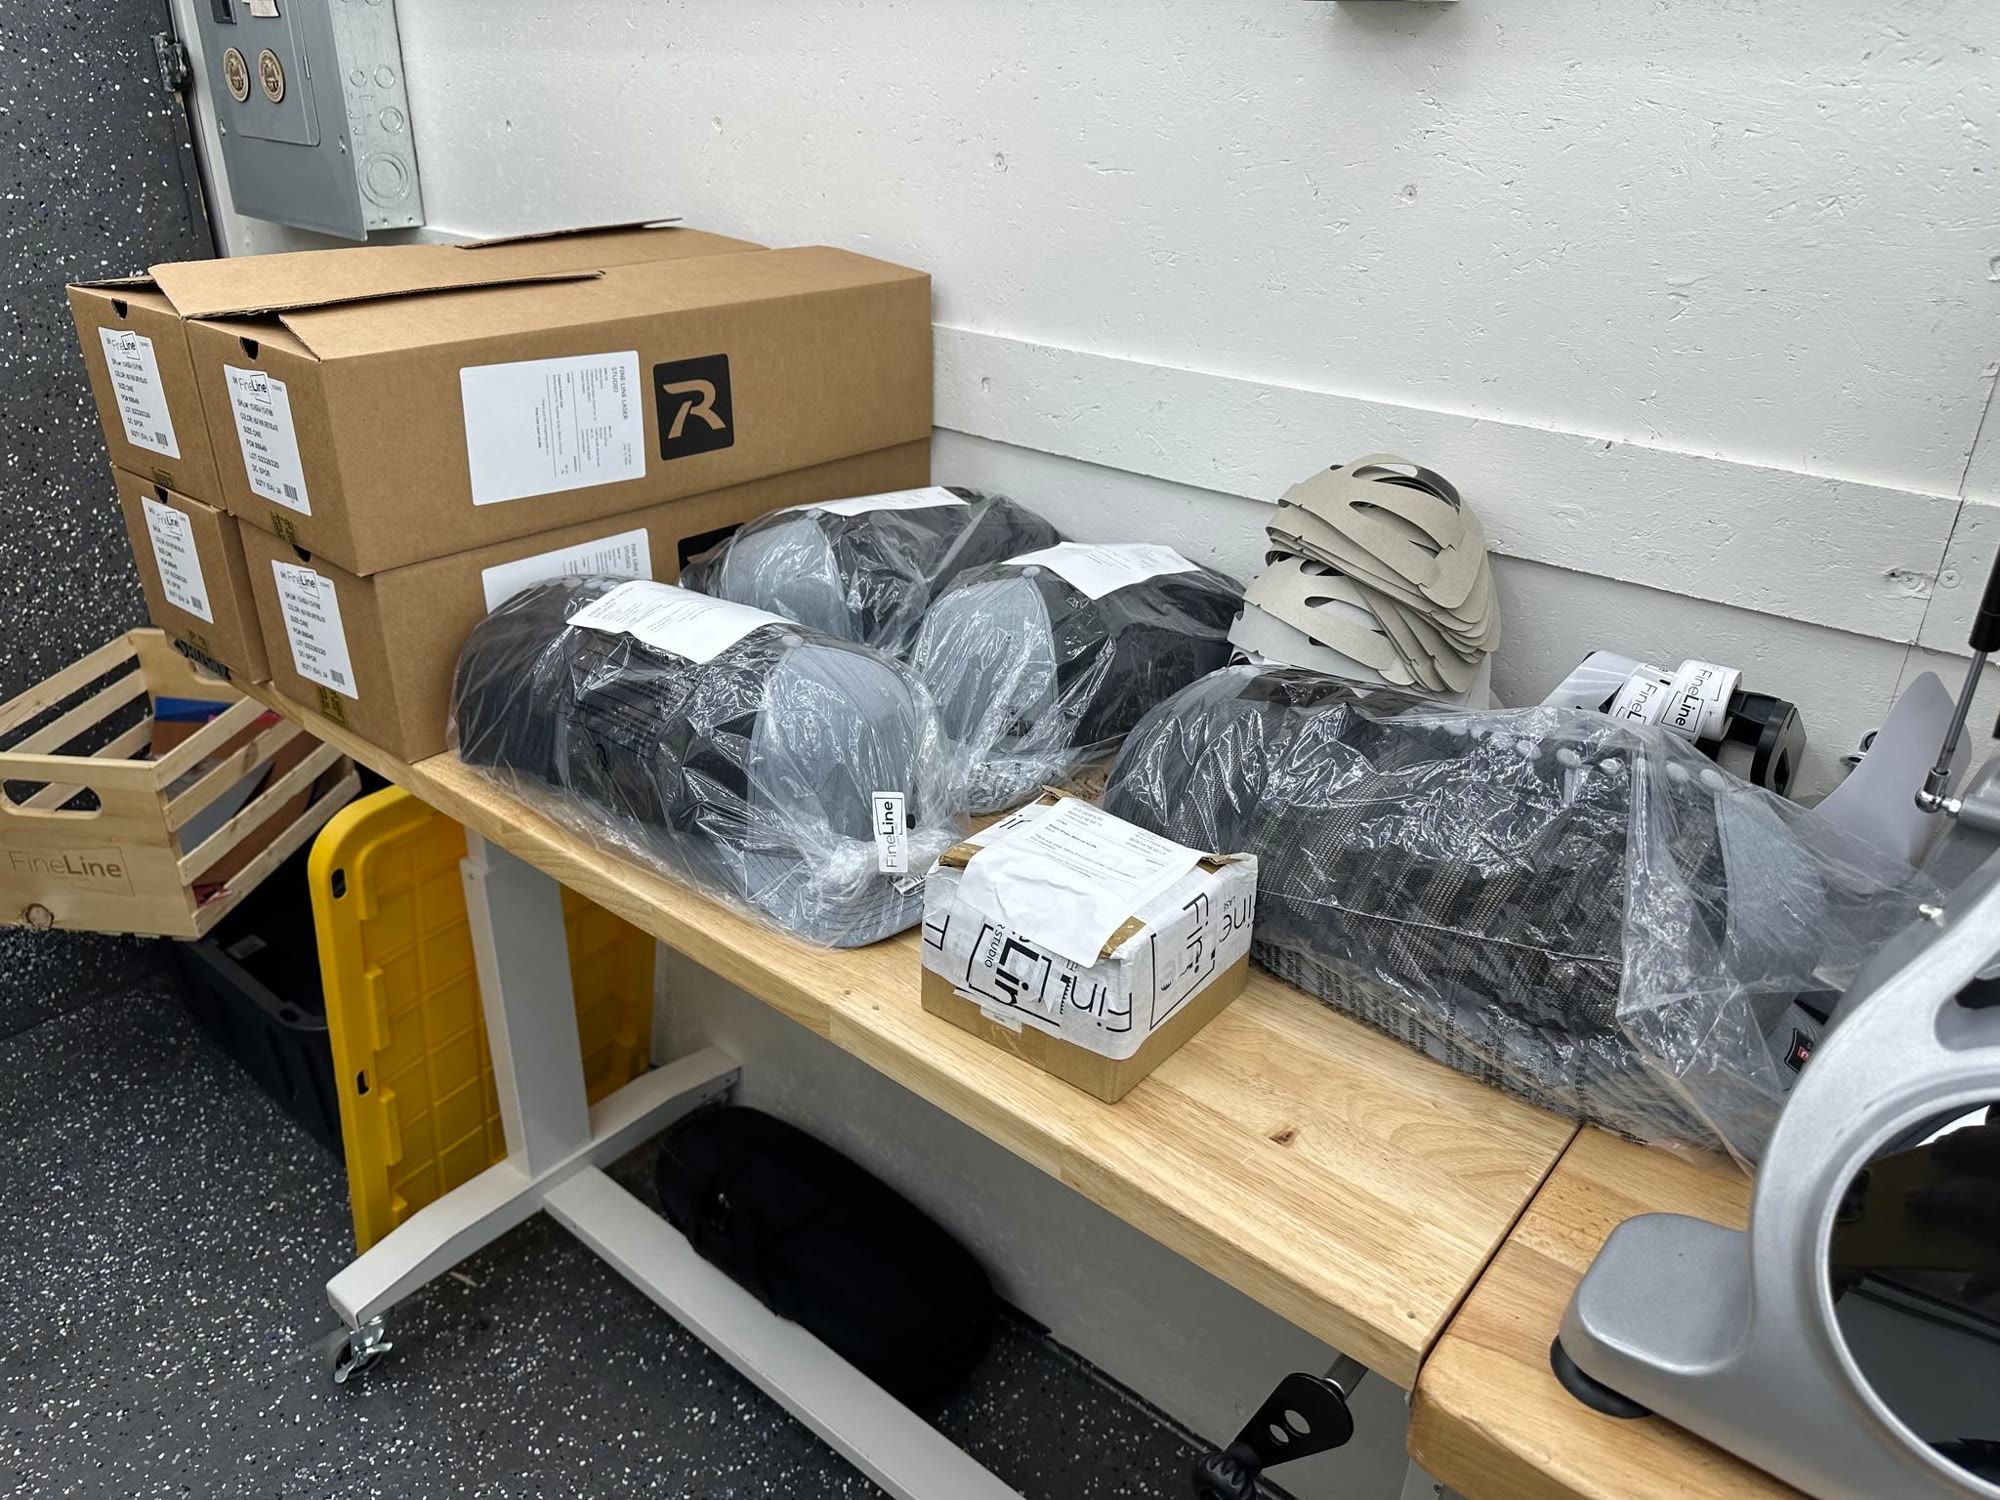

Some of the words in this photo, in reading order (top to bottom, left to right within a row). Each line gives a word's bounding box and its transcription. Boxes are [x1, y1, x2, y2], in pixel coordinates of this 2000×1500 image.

[239, 377, 267, 393] FineLine
[1675, 668, 1713, 726] FineLine
[882, 801, 897, 868] FineLine
[8, 850, 122, 878] FineLine
